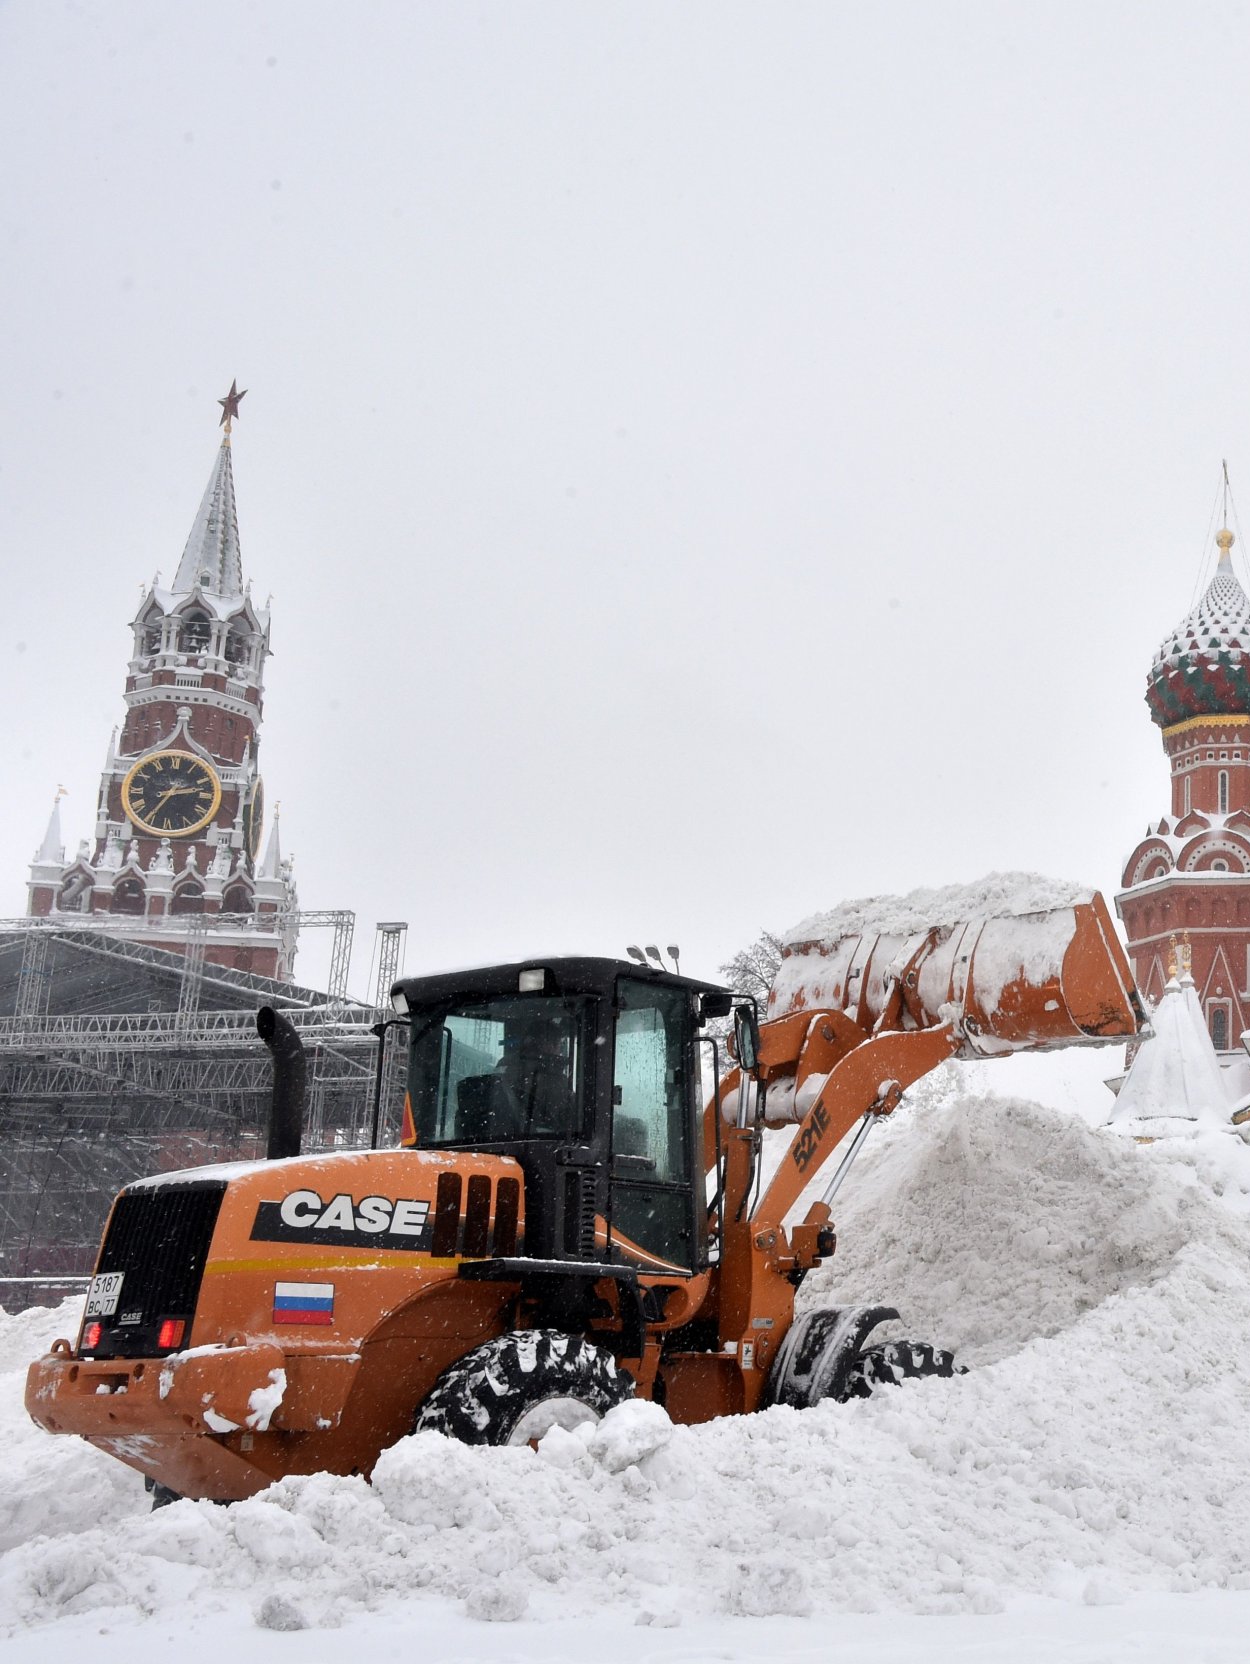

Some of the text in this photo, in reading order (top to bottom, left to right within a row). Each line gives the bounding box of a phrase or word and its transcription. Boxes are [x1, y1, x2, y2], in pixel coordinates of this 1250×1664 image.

[792, 1099, 831, 1174] 521E
[280, 1189, 430, 1236] CASE
[94, 1275, 120, 1294] 5187
[104, 1298, 115, 1313] 77
[120, 1312, 143, 1321] CASE
